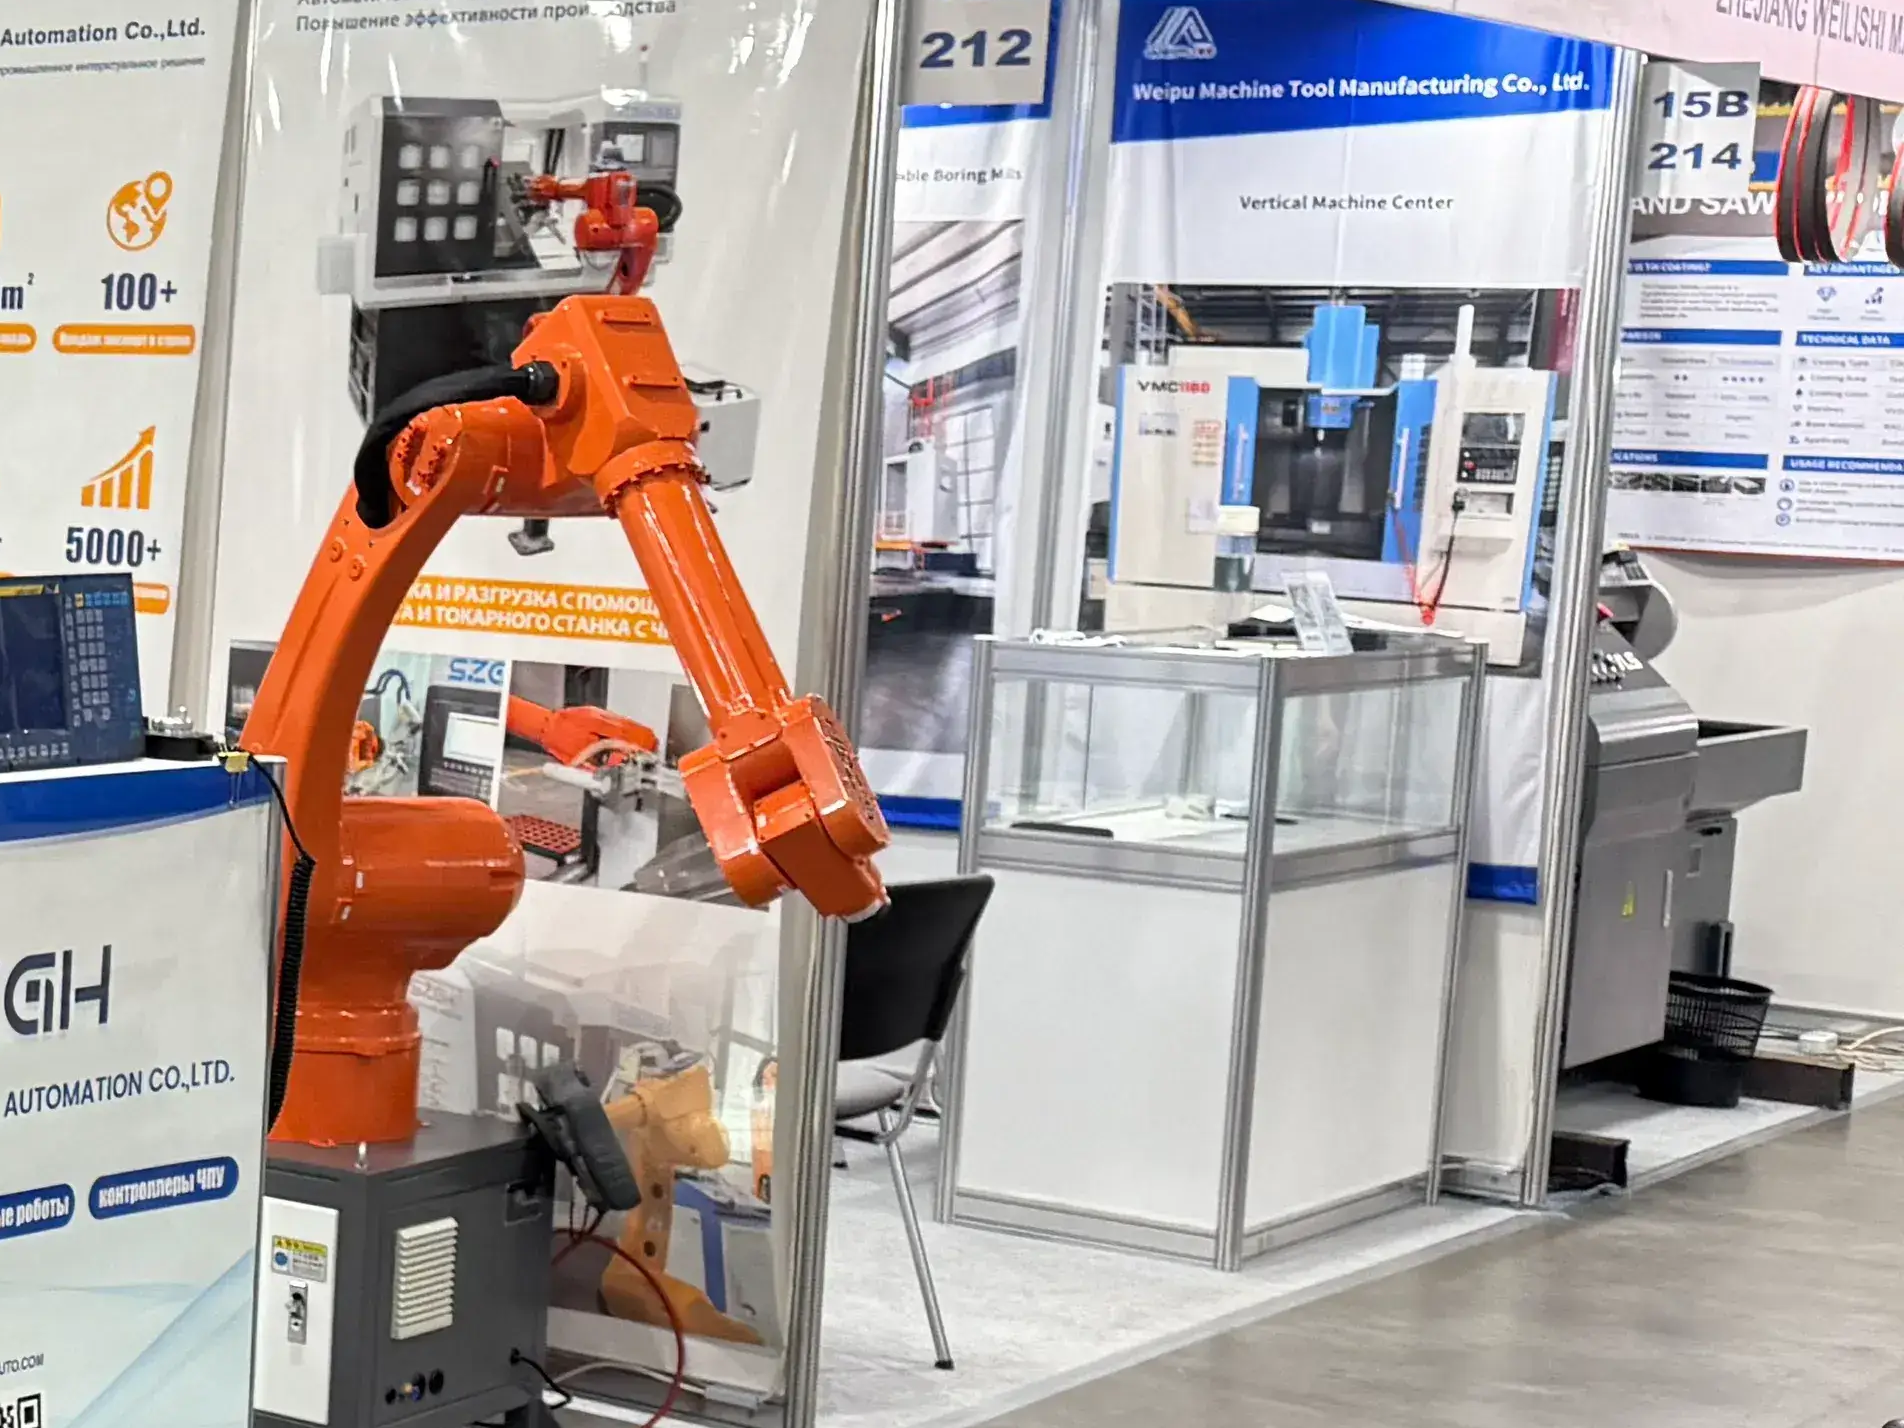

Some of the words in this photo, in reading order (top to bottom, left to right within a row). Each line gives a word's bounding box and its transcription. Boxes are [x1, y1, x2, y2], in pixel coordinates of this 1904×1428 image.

[0, 23, 118, 47] Automation
[124, 17, 206, 42] Co.,Ltd.
[296, 14, 401, 32] Повышение
[919, 28, 1033, 69] 212
[1132, 82, 1195, 104] Weipu
[1199, 80, 1284, 100] Machine
[1288, 78, 1335, 98] Tool
[1339, 73, 1499, 99] Manufacturing
[1652, 90, 1749, 118] 15B
[1647, 143, 1742, 170] 214
[933, 168, 986, 185] Boring
[1240, 193, 1307, 211] Vertical
[1312, 193, 1387, 211] Machine
[1391, 193, 1454, 211] Center
[100, 272, 178, 311] 100+
[65, 527, 162, 567] 5000+
[453, 586, 559, 609] РАЗГРУЗКА
[577, 595, 659, 616] ПОМОЩ
[435, 607, 551, 631] ТОКАРНОГО
[553, 616, 630, 637] СТАНКА
[4, 1071, 143, 1119] AUTOMATION
[148, 1060, 235, 1094] CO.,LTD.
[98, 1172, 195, 1211] контроллеры
[196, 1165, 225, 1192] ЧПУ
[16, 1193, 70, 1231] роботы
